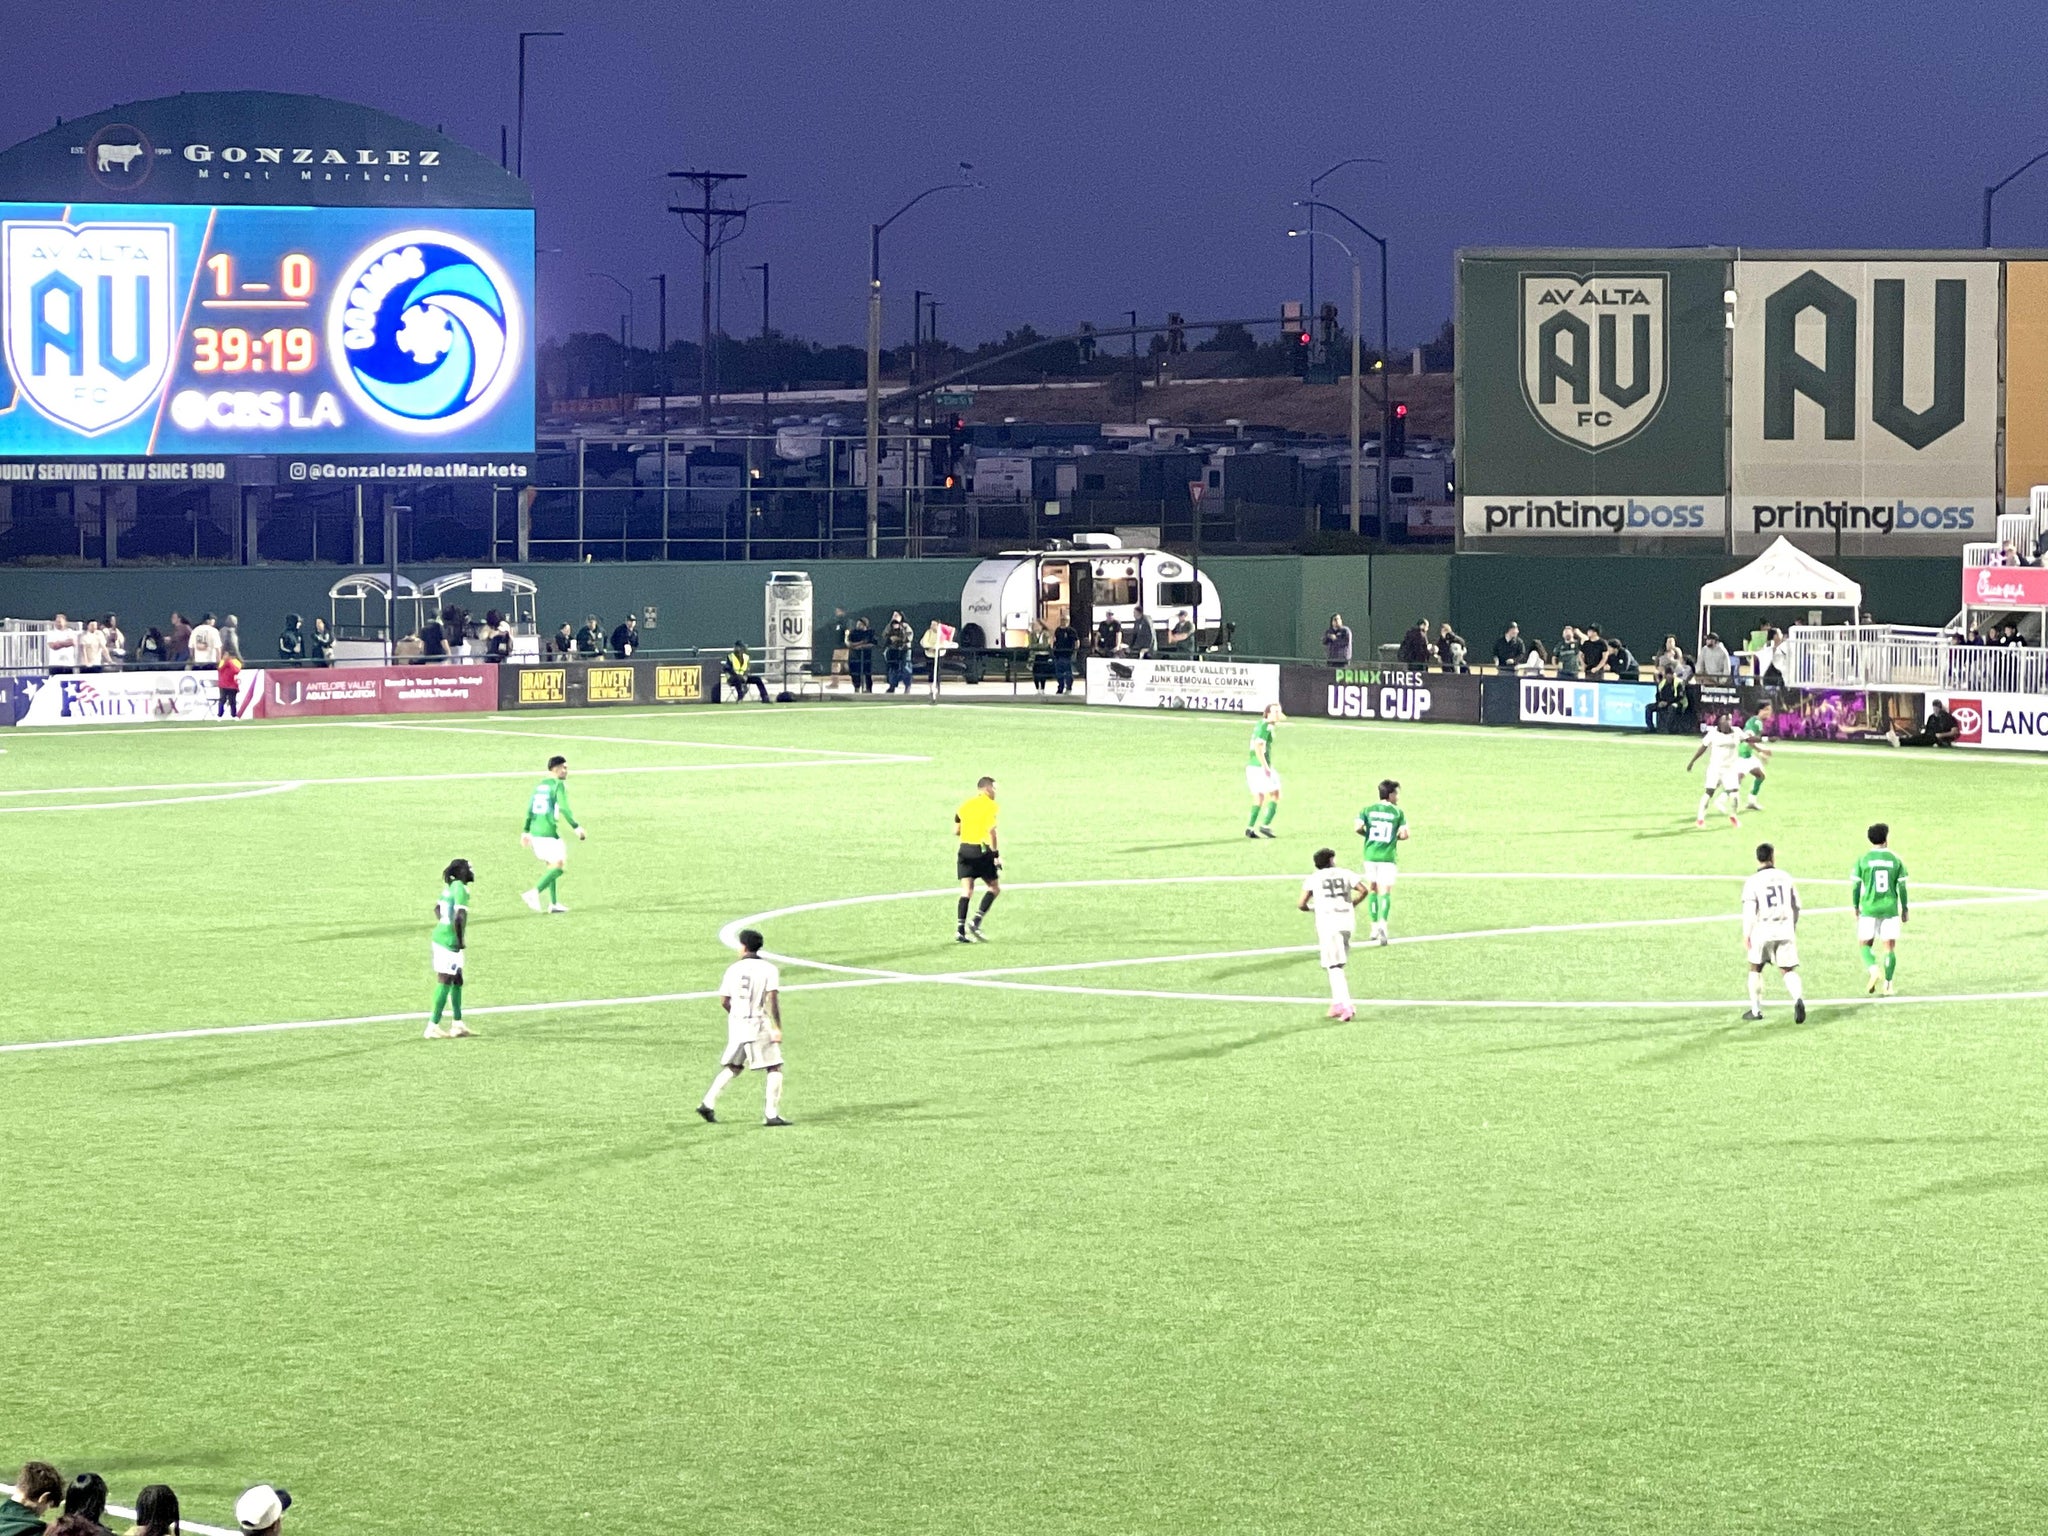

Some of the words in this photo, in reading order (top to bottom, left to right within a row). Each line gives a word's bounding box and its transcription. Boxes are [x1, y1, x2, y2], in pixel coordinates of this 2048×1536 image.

[183, 144, 440, 166] GONZALEZ
[199, 169, 270, 181] Meat
[301, 170, 428, 183] Markets
[77, 245, 149, 261] ALTA
[206, 253, 232, 297] 1
[281, 253, 313, 298] 0
[1537, 288, 1575, 306] AV
[1579, 288, 1651, 306] ALTA
[193, 327, 314, 372] 39:19
[74, 387, 108, 403] FC
[288, 391, 344, 428] LA
[1577, 412, 1613, 428] FC
[38, 464, 97, 480] SERVING
[100, 464, 125, 480] THE
[127, 464, 146, 480] AV
[148, 463, 188, 479] SINCE
[191, 463, 225, 479] 1990
[309, 463, 528, 480] @GonzalezMeatMarkets
[1485, 499, 1704, 533] printingboss
[1752, 500, 1975, 534] printingboss
[1742, 591, 1817, 600] REFISNACKS
[658, 669, 698, 686] BRAVERY
[1154, 664, 1197, 674] ANTELOPE
[1199, 665, 1237, 676] VALLEY'S
[1336, 669, 1381, 685] PRINX
[1383, 671, 1423, 687] TIRES
[306, 681, 345, 691] ANTELOPE
[347, 680, 376, 690] VALLEY
[522, 672, 562, 688] BRAVERY
[590, 671, 631, 687] BRAVERY
[1107, 680, 1136, 689] ALONZO
[1150, 675, 1171, 684] JUNK
[1174, 675, 1212, 686] REMOVAL
[1214, 677, 1255, 688] COMPANY
[305, 690, 331, 700] ADULT
[332, 689, 376, 700] EDUCATION
[1327, 685, 1375, 718] USL
[1380, 687, 1431, 720] CUP
[1525, 685, 1572, 717] USL
[1322, 877, 1346, 899] 99
[1875, 870, 1889, 892] 8
[1766, 885, 1784, 908] 21
